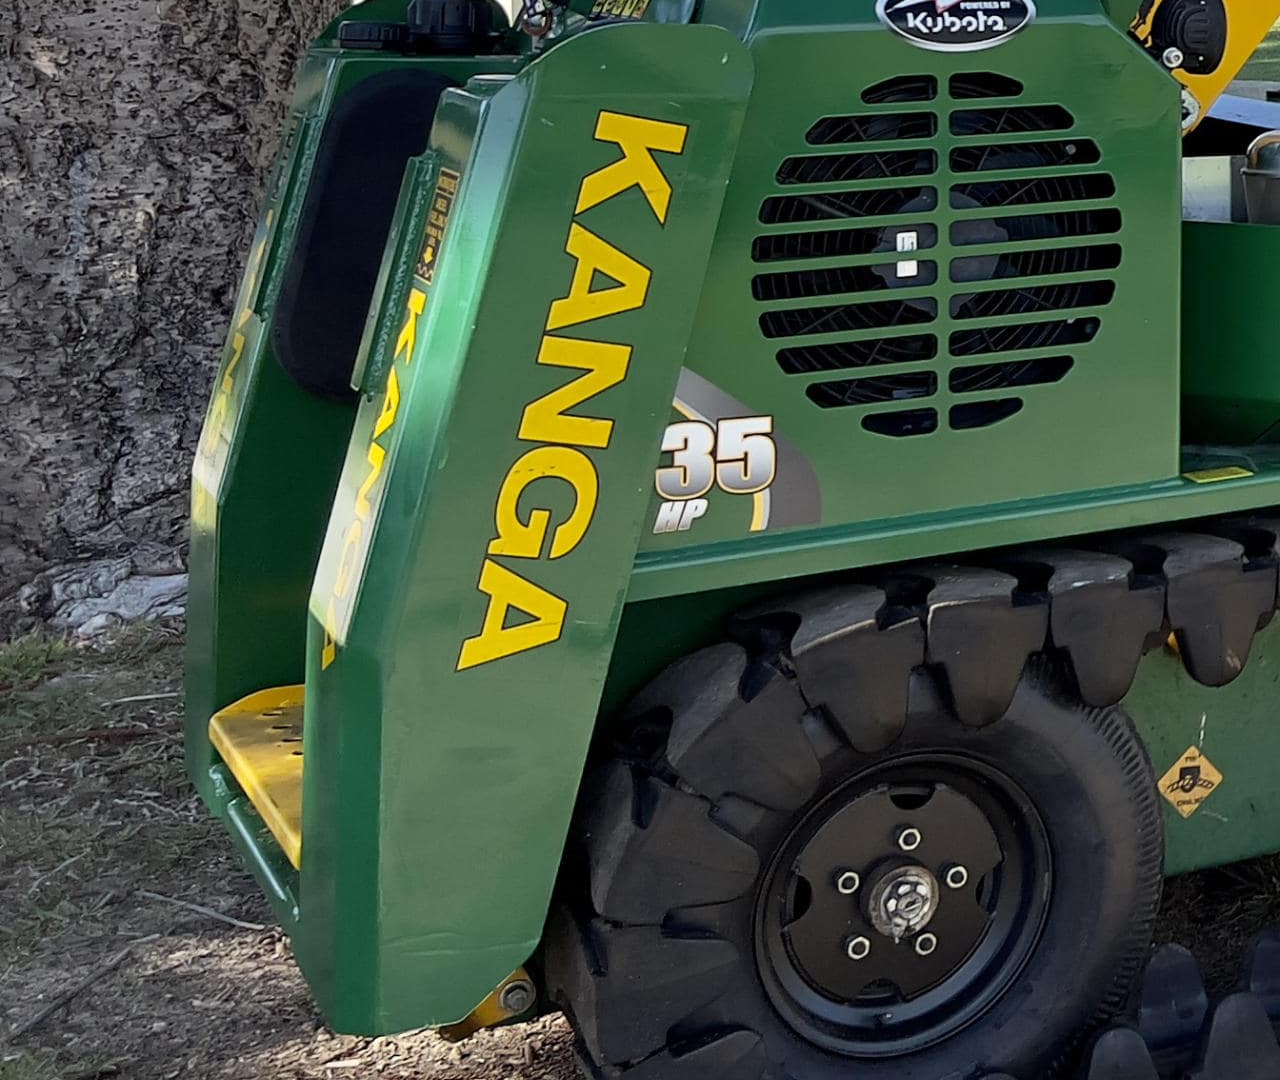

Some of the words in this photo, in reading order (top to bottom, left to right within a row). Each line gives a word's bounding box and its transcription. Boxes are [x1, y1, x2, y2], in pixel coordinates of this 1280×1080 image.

[906, 10, 1005, 34] Kubota
[960, 1, 1000, 11] POWERED
[1000, 1, 1011, 10] BY
[456, 110, 689, 671] KANGA
[655, 416, 776, 500] 35
[653, 498, 709, 534] HP
